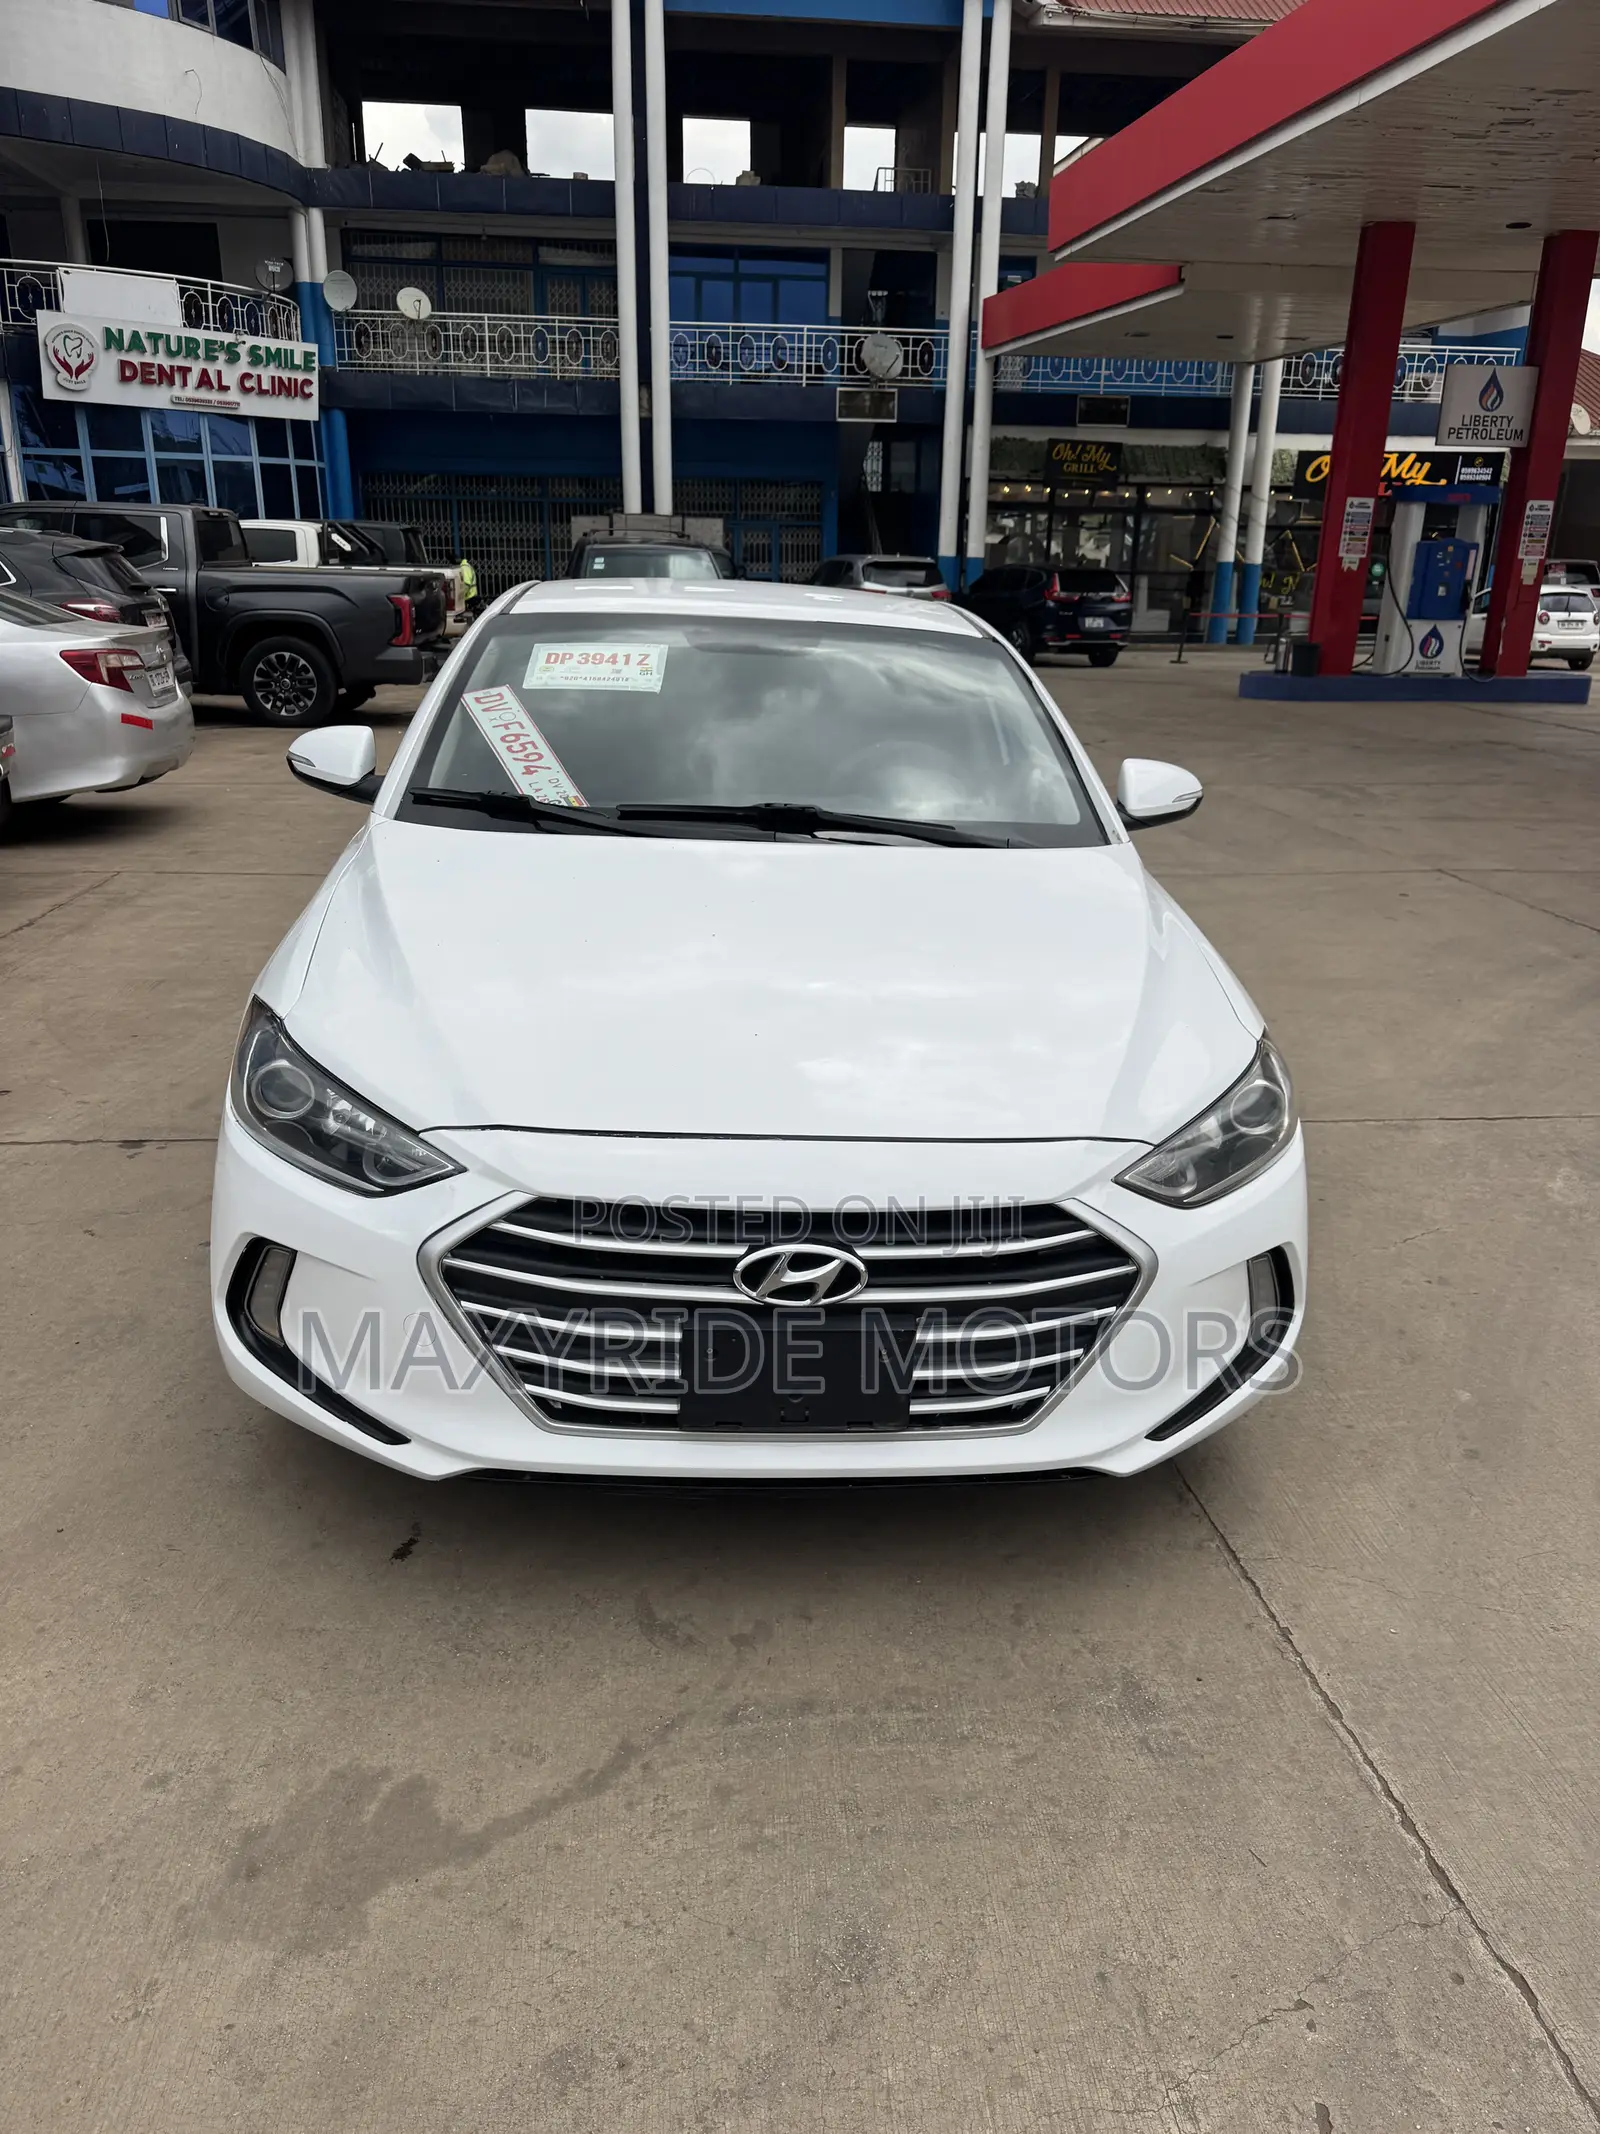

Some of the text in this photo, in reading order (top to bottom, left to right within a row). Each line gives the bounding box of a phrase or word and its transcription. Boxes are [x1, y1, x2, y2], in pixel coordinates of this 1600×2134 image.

[103, 326, 241, 364] NATURE'S
[247, 344, 316, 372] SMILE
[117, 359, 314, 399] DENTAL CLINIC
[1461, 414, 1514, 428] LIBERTY
[1447, 427, 1524, 441] PETROLEUM
[1052, 443, 1117, 471] Oh! My
[1063, 462, 1097, 473] GRILL
[545, 653, 651, 666] DP 3941 Z
[474, 692, 512, 713] DV
[492, 721, 552, 776] F6594
